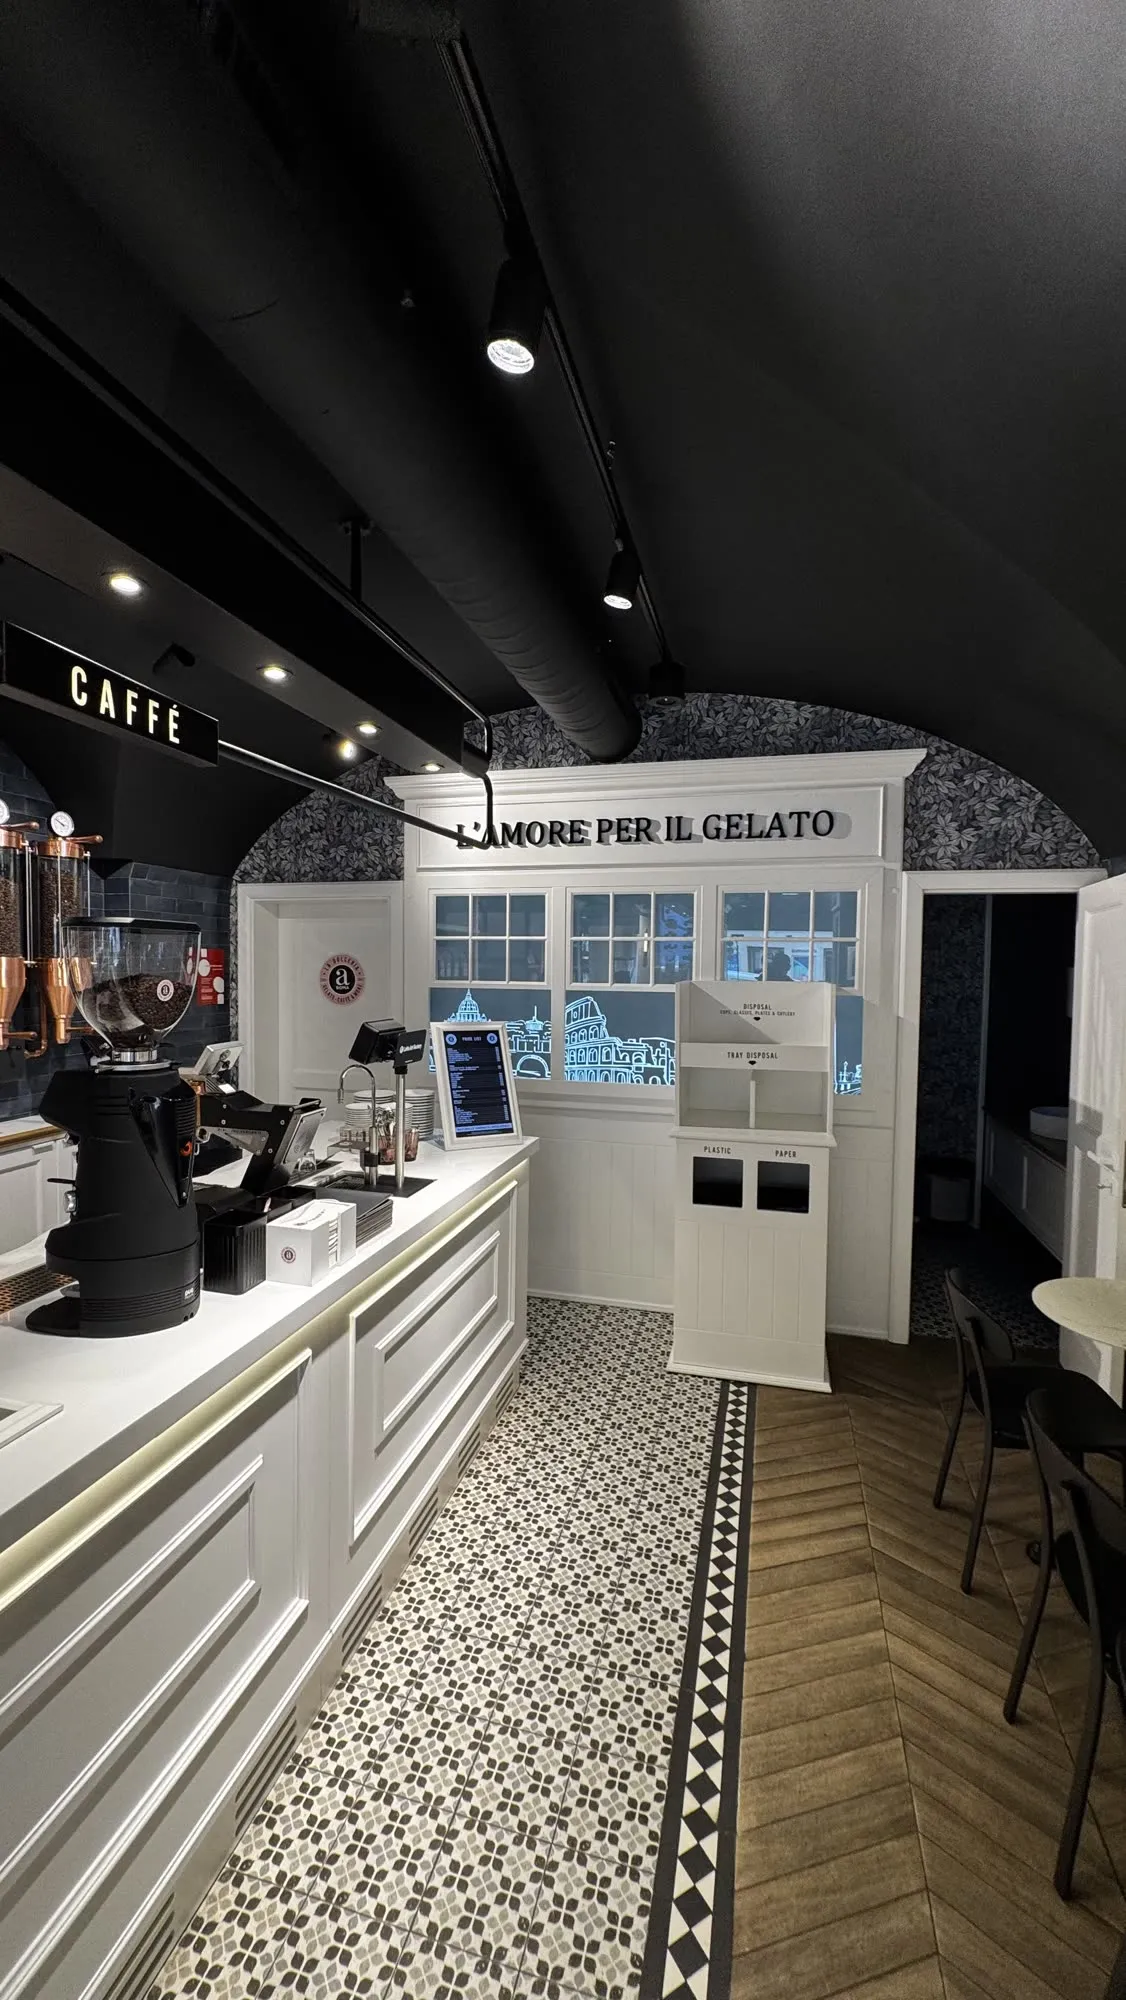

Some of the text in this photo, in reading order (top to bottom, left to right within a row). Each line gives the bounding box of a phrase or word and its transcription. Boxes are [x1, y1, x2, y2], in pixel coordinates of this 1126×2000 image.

[71, 665, 180, 745] CAFFÉ
[596, 817, 655, 843] PER
[665, 815, 692, 841] IL
[702, 809, 835, 840] GELATO
[727, 1051, 778, 1060] TRAY DISPOSAL
[703, 1145, 732, 1155] PLASTIC
[775, 1149, 797, 1158] PAPER
